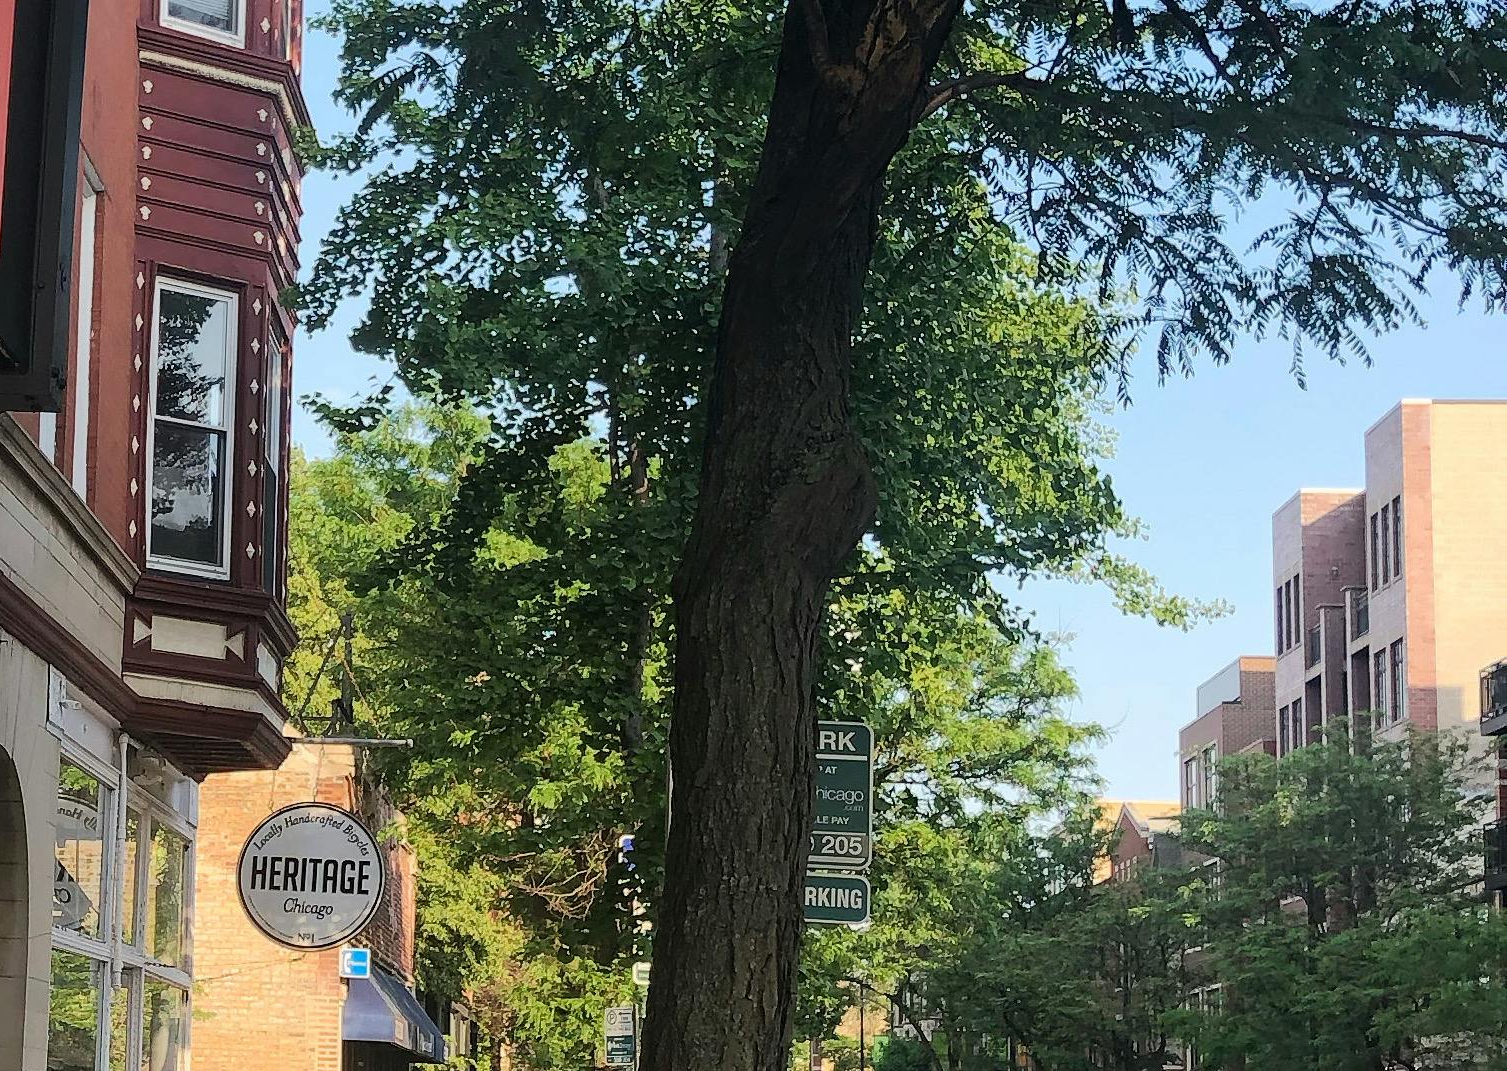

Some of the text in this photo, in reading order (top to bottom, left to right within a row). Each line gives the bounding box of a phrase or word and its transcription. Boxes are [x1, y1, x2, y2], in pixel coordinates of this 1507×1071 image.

[818, 730, 856, 752] RK
[816, 786, 864, 805] hicago
[815, 815, 850, 825] LE PAY
[253, 813, 370, 857] Locally Handcrafted Bicycles
[821, 836, 863, 856] 205
[250, 855, 371, 896] HERITAGE
[283, 897, 334, 920] Chicago
[804, 886, 863, 910] RKING
